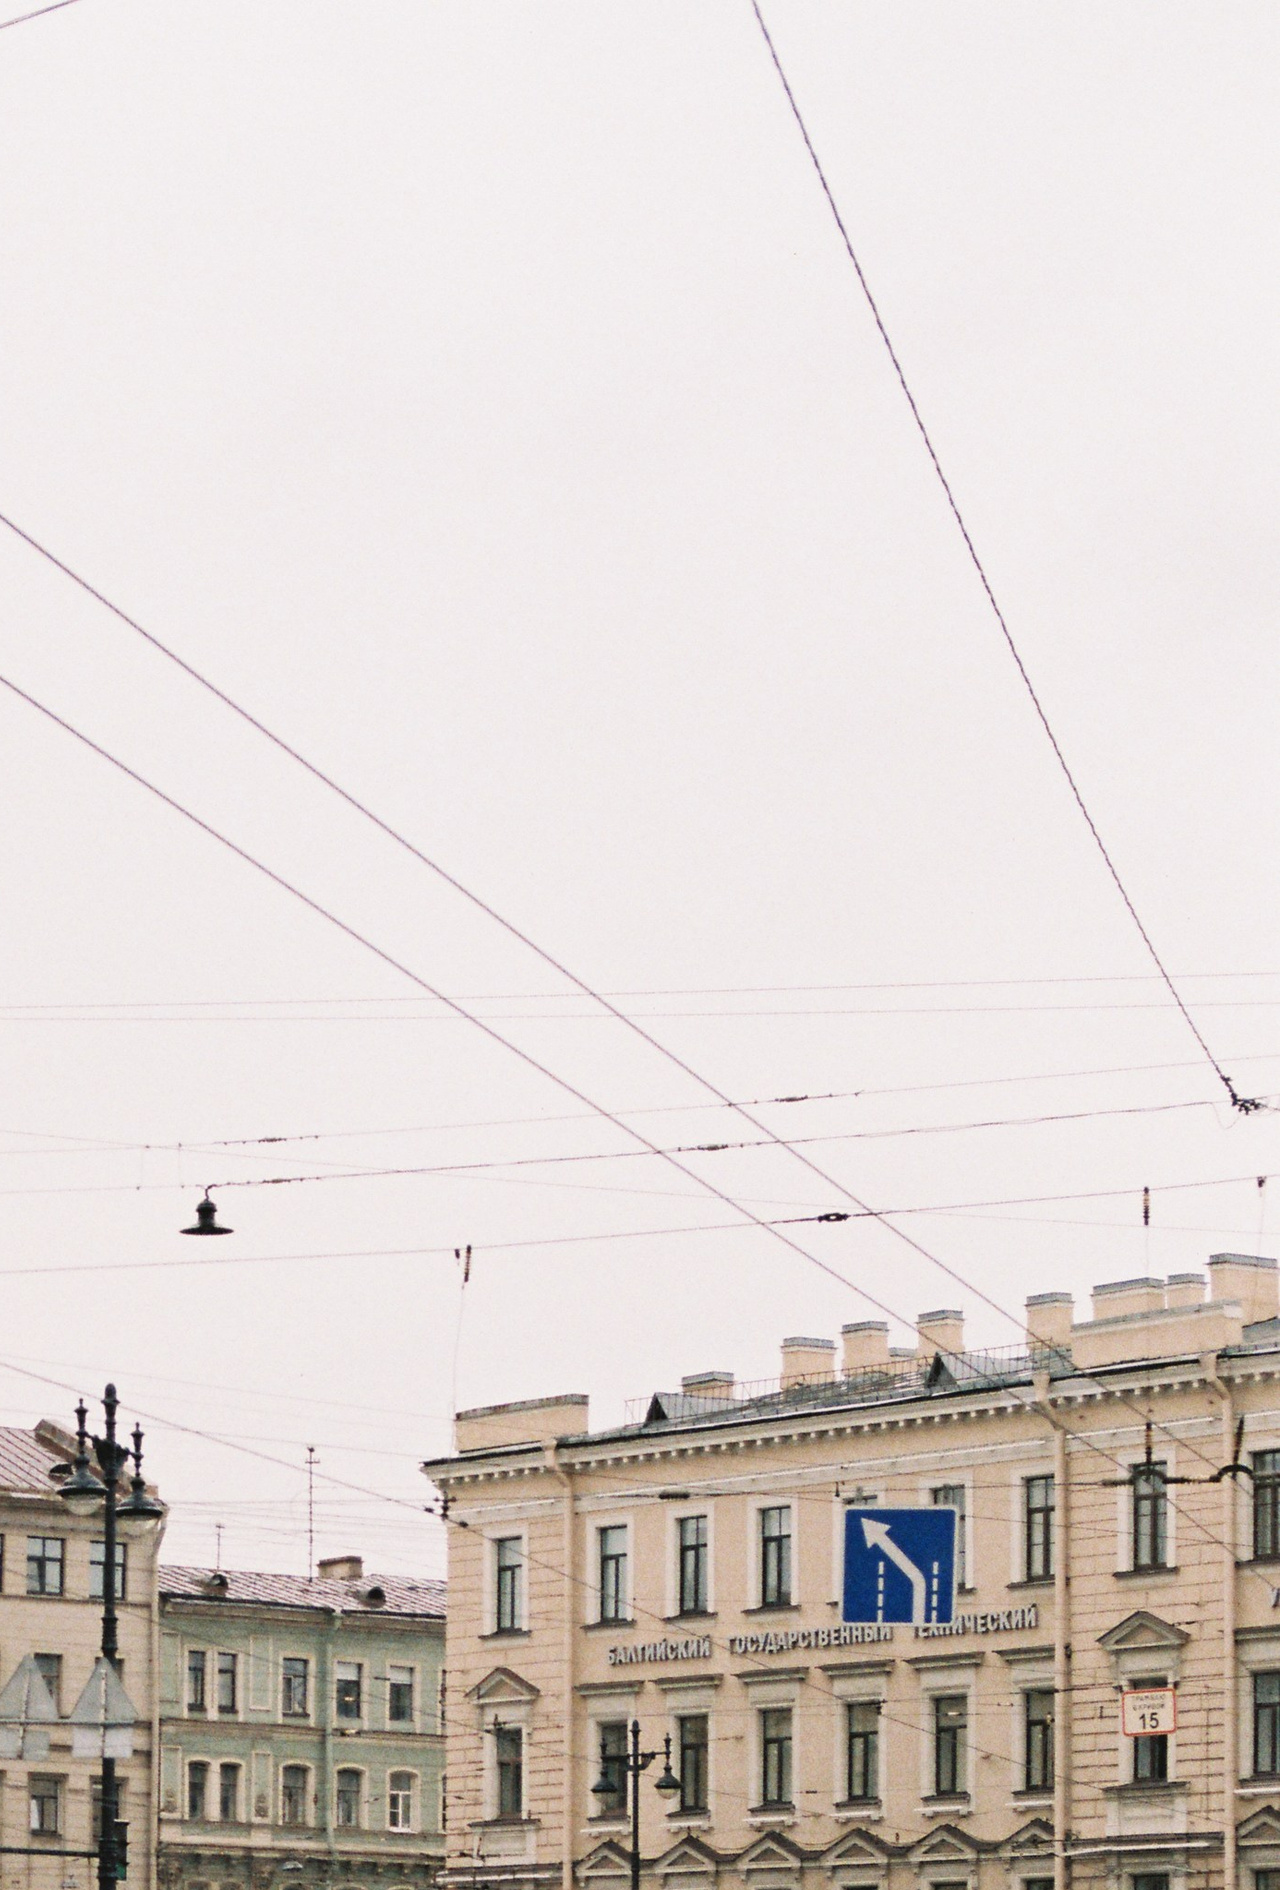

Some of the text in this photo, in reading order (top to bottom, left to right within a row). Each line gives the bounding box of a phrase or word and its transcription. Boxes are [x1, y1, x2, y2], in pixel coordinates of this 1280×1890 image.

[608, 1635, 712, 1665] БАЛТИЙСКИЙ
[729, 1626, 893, 1655] ГОСУДАРСТВЕННЫЙ
[1139, 1712, 1159, 1729] 15
